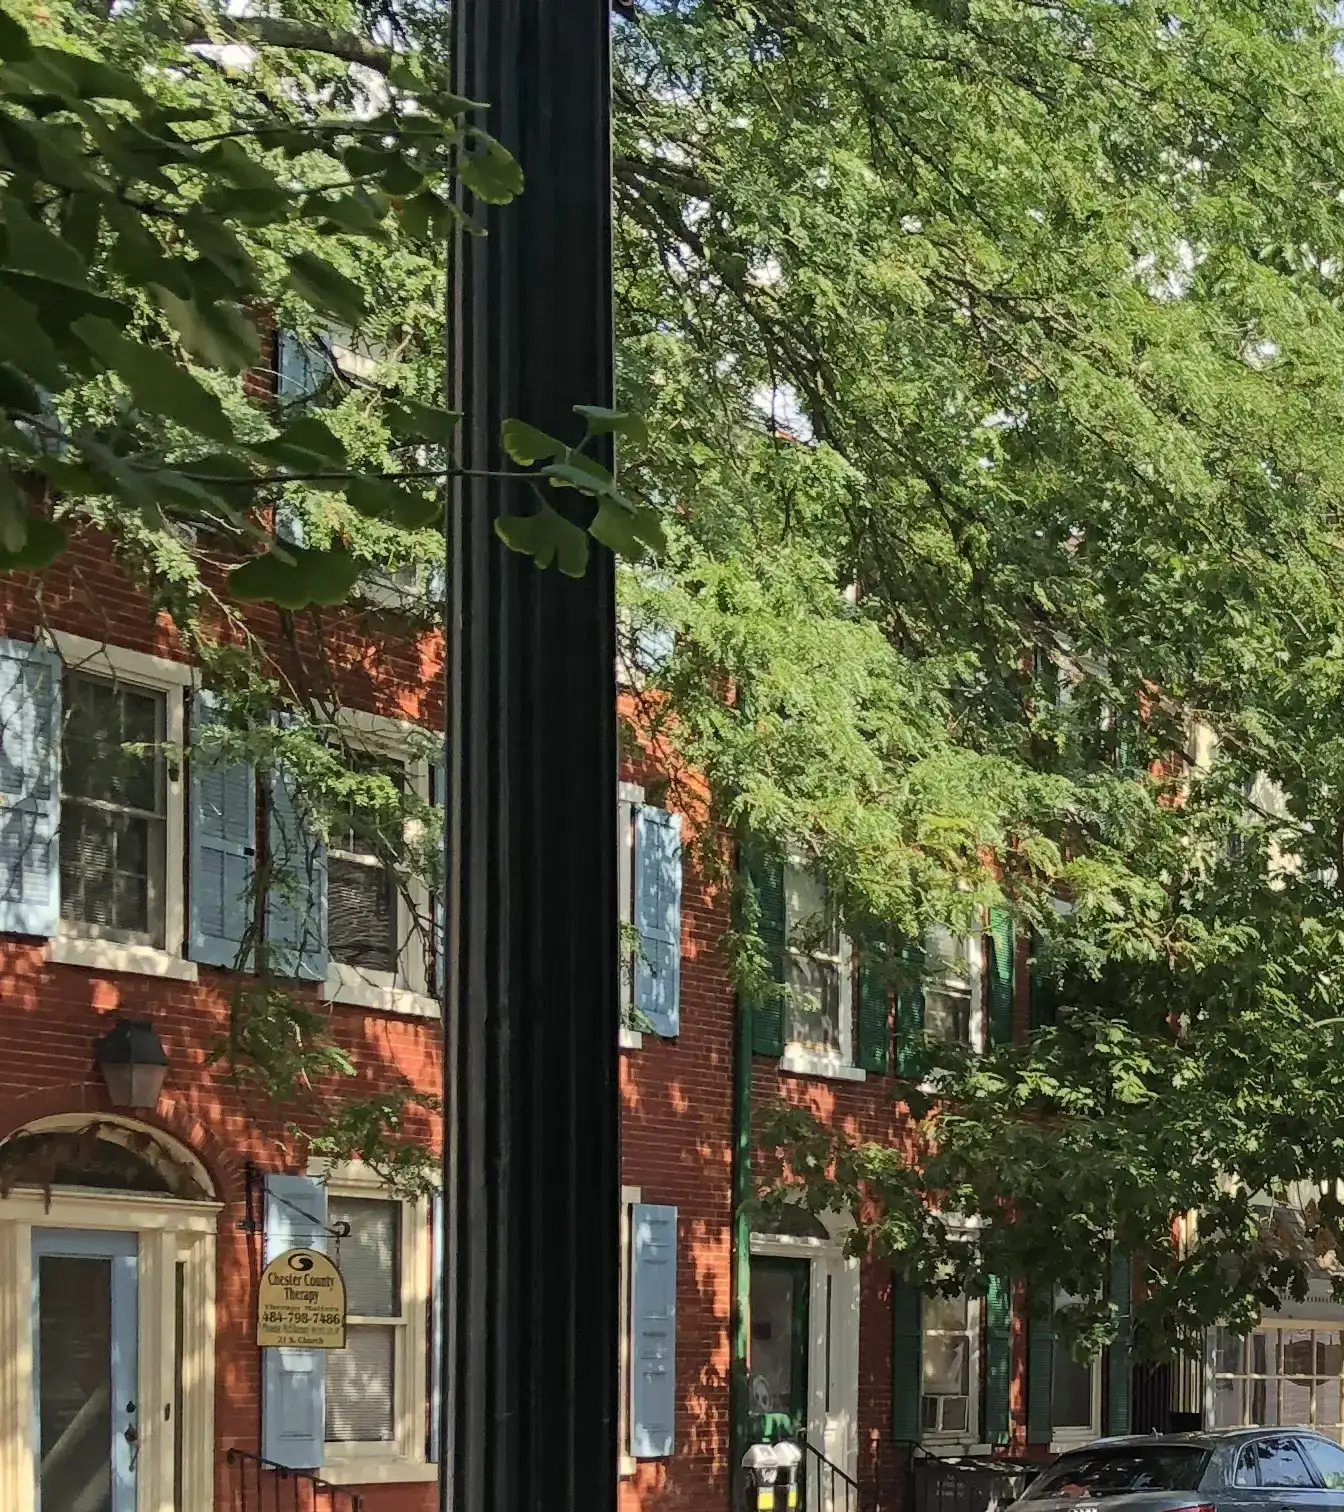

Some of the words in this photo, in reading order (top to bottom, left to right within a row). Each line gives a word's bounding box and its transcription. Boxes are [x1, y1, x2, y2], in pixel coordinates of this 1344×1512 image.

[268, 1272, 302, 1287] Chester
[304, 1273, 335, 1291] County
[284, 1287, 319, 1304] Therapy
[262, 1311, 340, 1324] 484-798-7486
